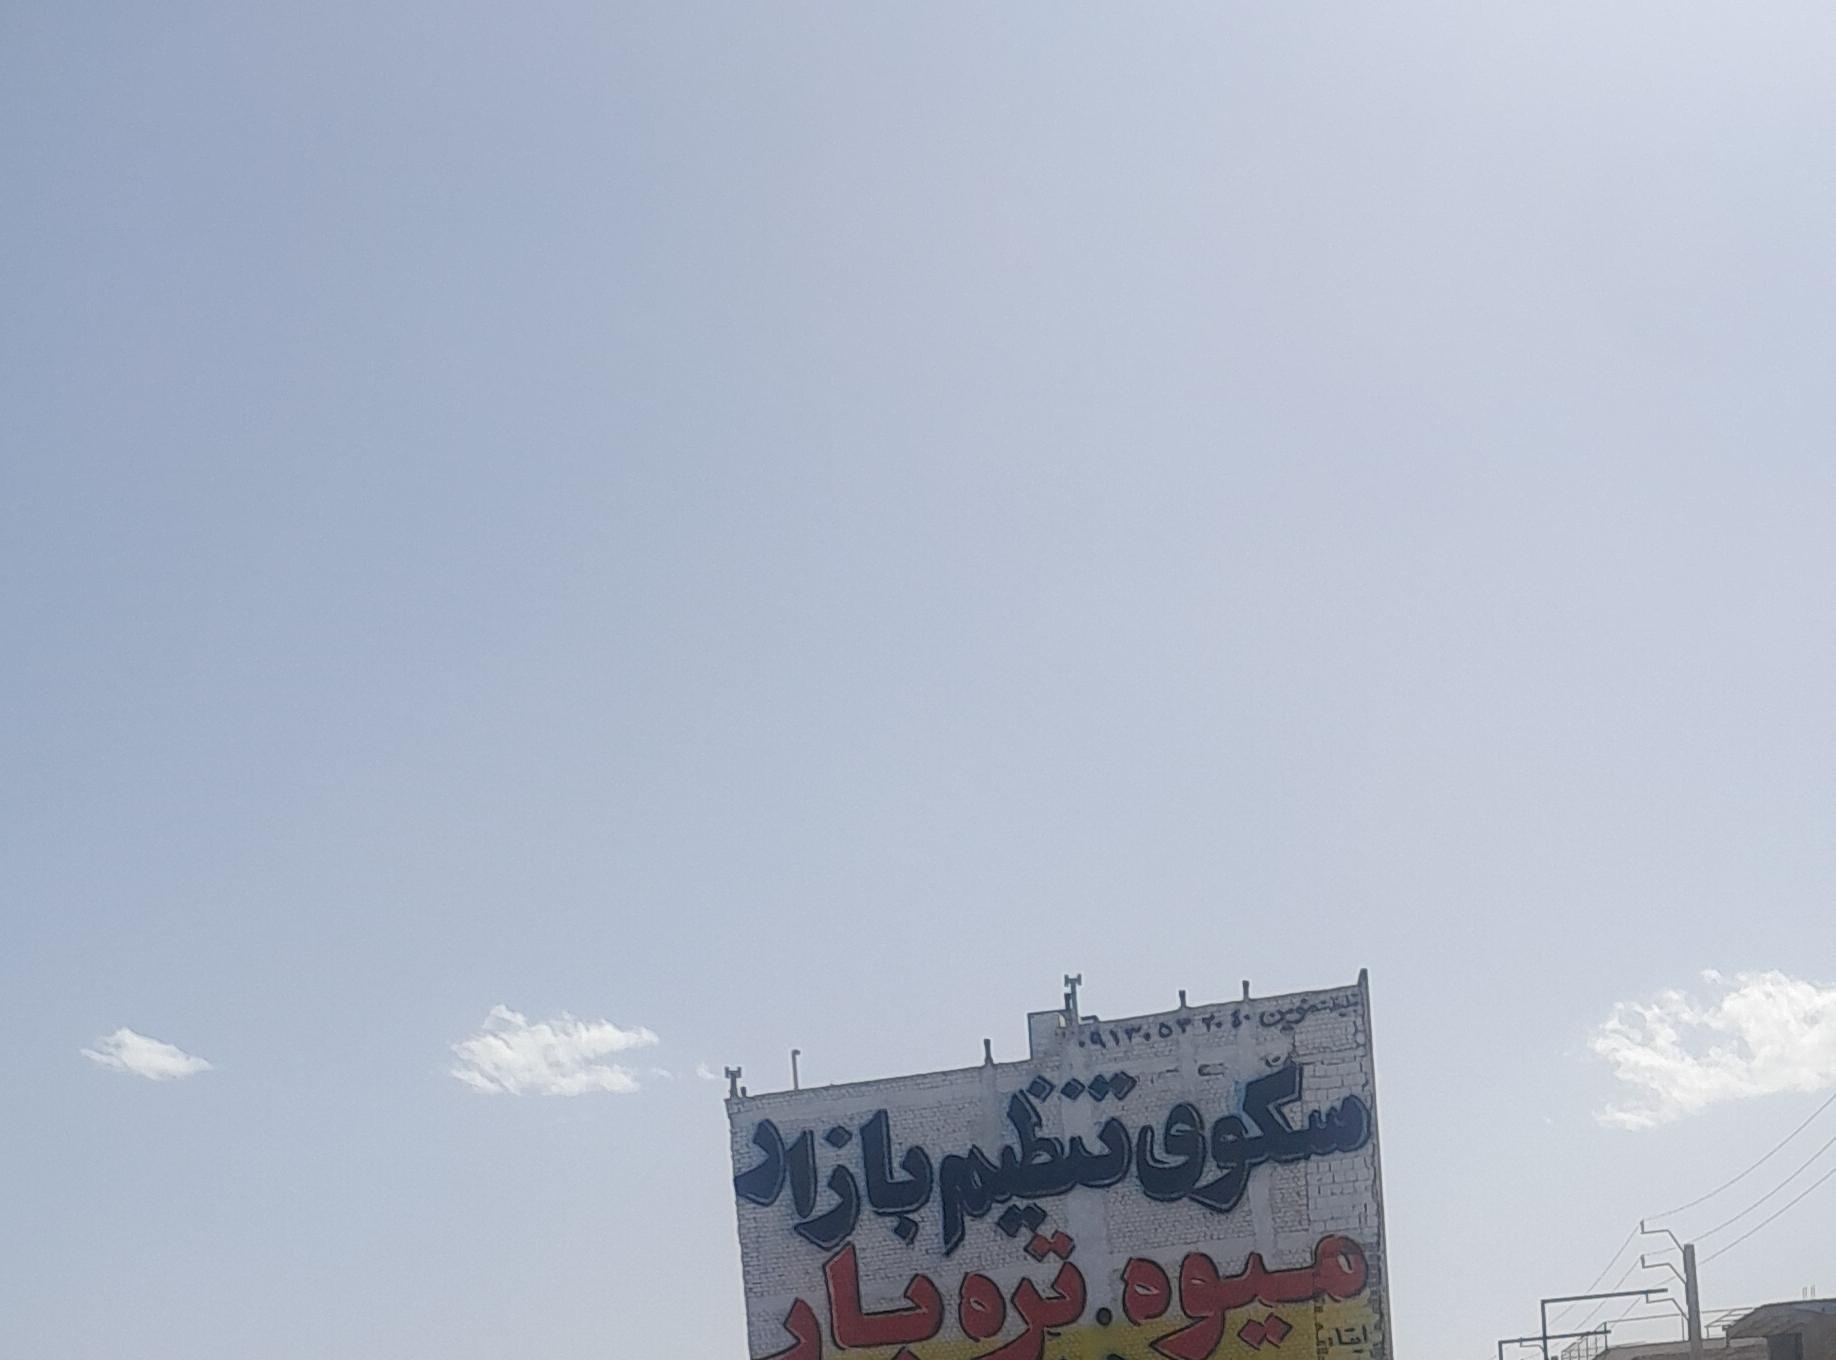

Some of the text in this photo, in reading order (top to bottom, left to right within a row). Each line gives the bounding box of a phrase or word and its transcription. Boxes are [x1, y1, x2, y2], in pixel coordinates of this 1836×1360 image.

[735, 1063, 1372, 1256] سکوی تنظیم بازار
